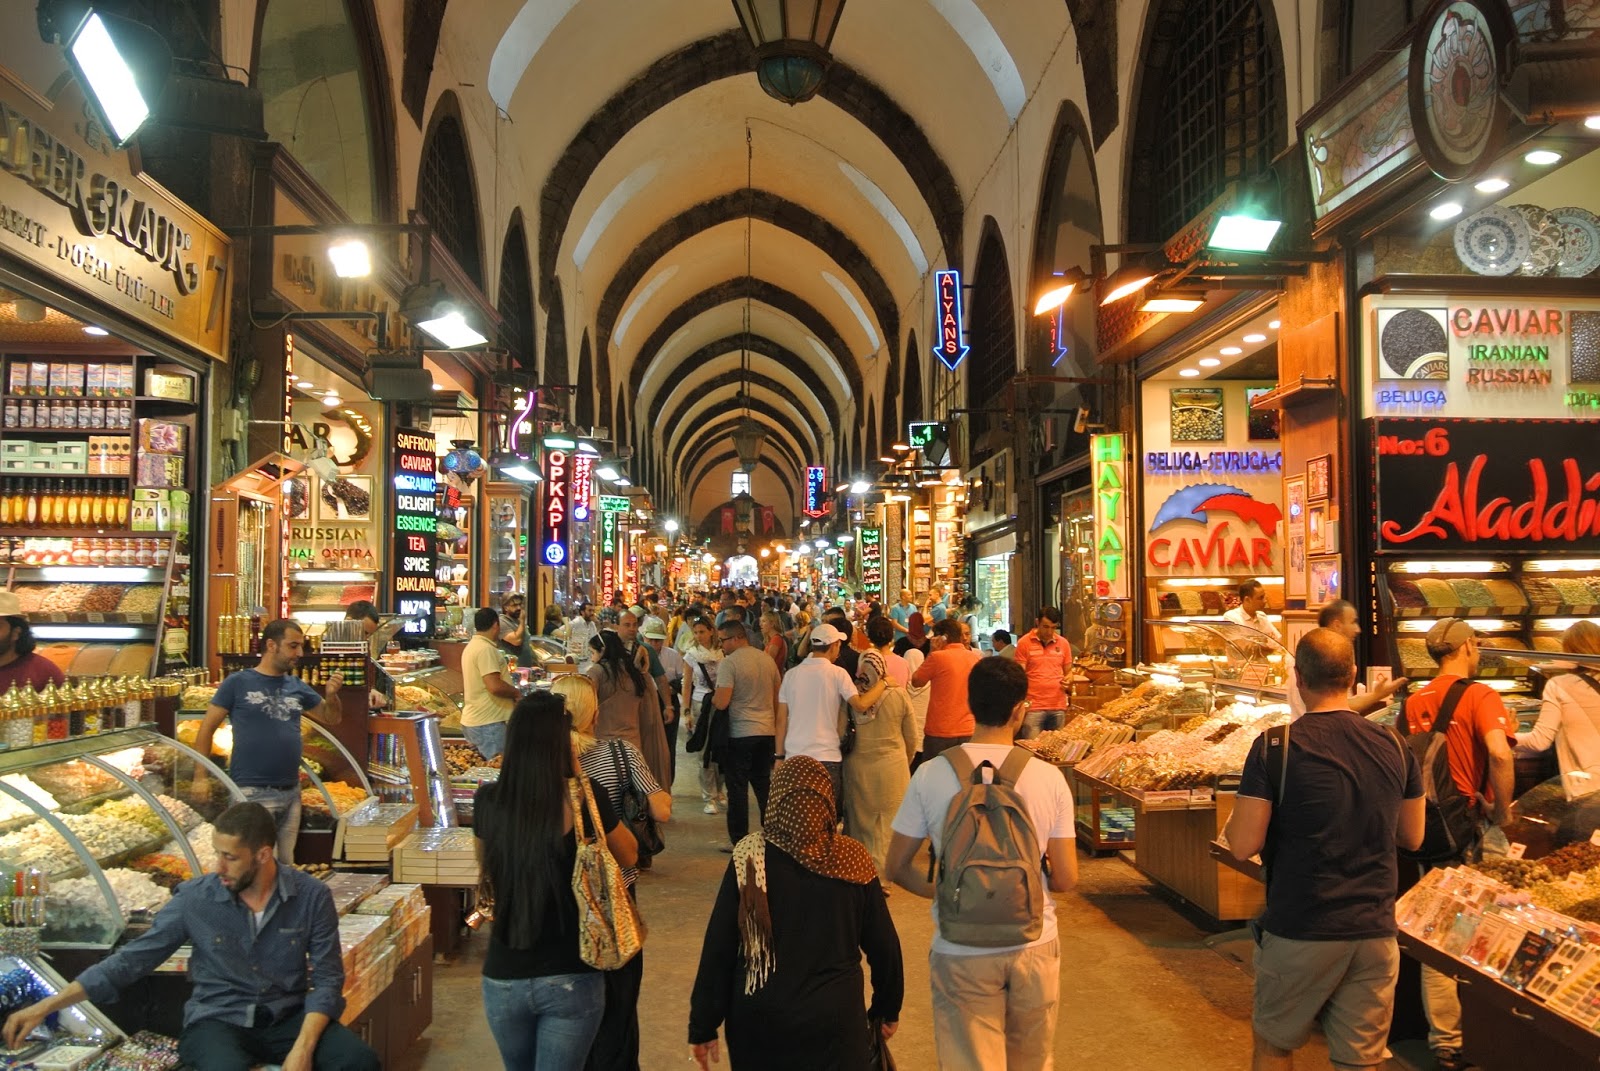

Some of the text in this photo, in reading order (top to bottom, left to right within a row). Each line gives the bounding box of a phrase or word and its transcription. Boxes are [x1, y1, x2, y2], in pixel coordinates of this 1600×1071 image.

[942, 274, 957, 353] ALYANS
[1453, 308, 1563, 335] CAVIAR
[1469, 345, 1549, 361] IRANIAN
[1467, 368, 1552, 384] RUSSIAN
[1379, 390, 1447, 405] BELUGA
[397, 434, 436, 453] SAFFRON
[401, 455, 432, 471] CAVIAR
[398, 495, 435, 513] DELIGHT
[1096, 435, 1122, 581] HAYAT
[397, 515, 436, 533] ESSENCE
[604, 512, 613, 553] CAVIAR
[292, 528, 367, 541] RUSSIAN
[408, 536, 425, 551] TEA
[1149, 522, 1273, 568] CAVIAR
[404, 556, 429, 572] SPICE
[396, 577, 435, 593] BAKLAVA
[1370, 561, 1378, 635] SPICES
[400, 600, 431, 615] NAZAR
